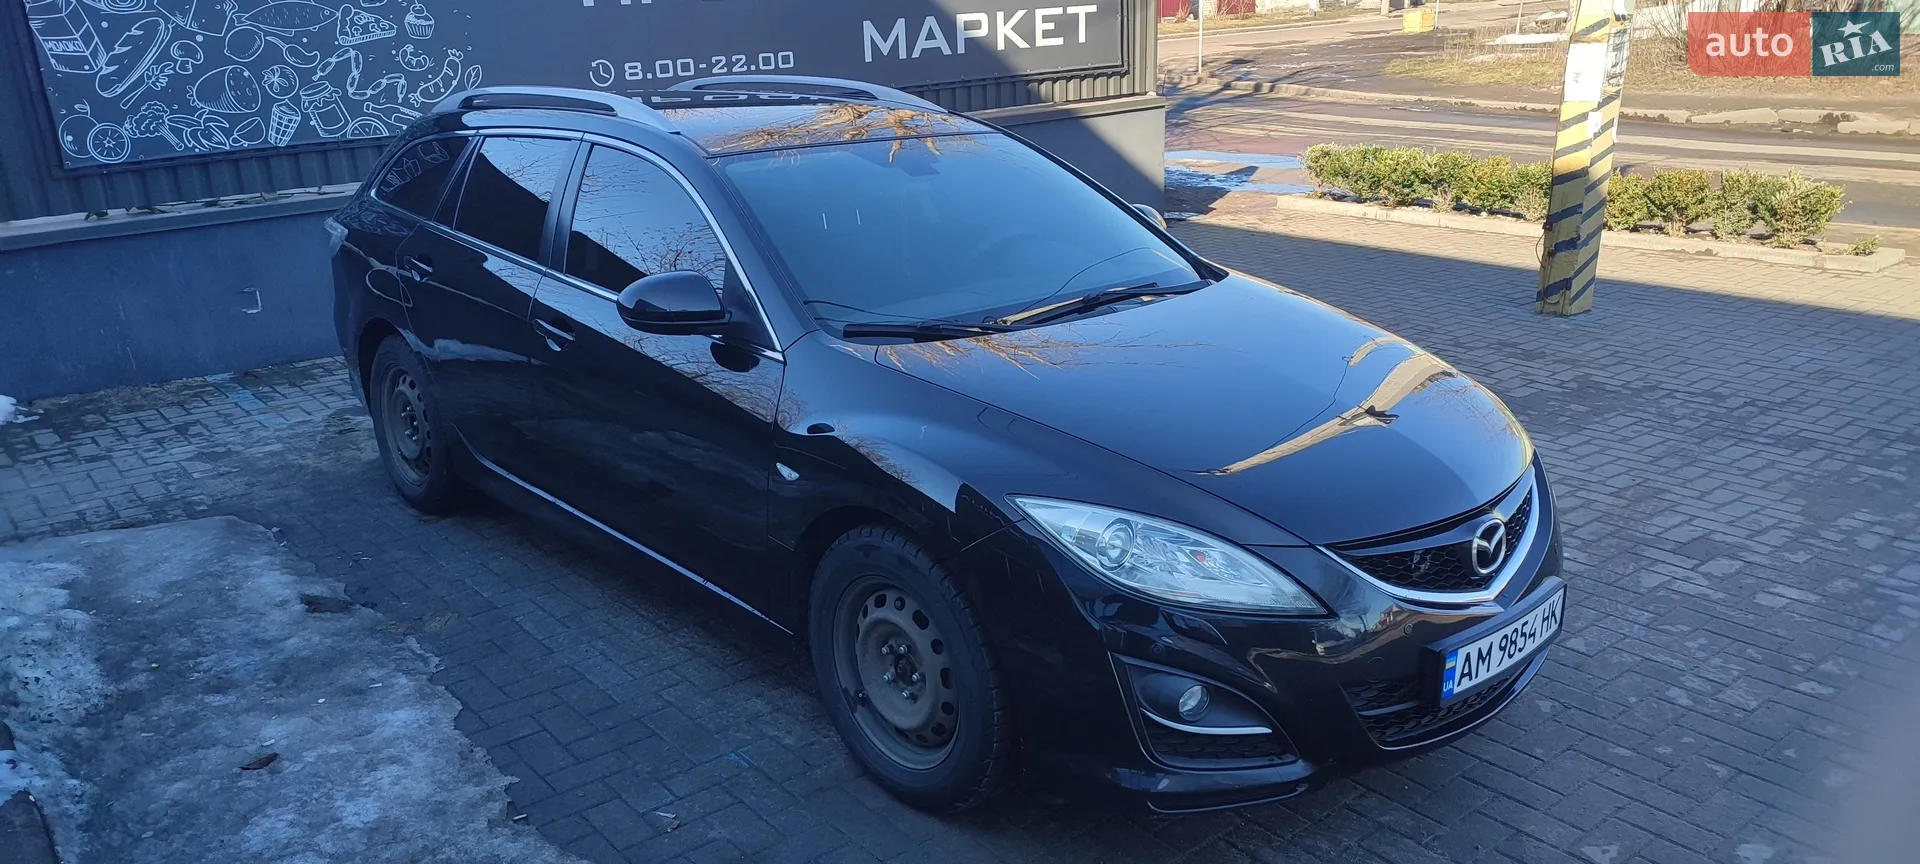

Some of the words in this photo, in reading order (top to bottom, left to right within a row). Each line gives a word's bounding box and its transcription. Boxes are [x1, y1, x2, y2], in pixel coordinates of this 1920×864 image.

[862, 4, 1098, 63] МАРКЕТ
[624, 51, 795, 81] 8.00-22.00
[1457, 641, 1494, 687] AM
[1497, 614, 1538, 668] 9854
[1540, 594, 1561, 639] HK
[1443, 681, 1453, 692] UA
